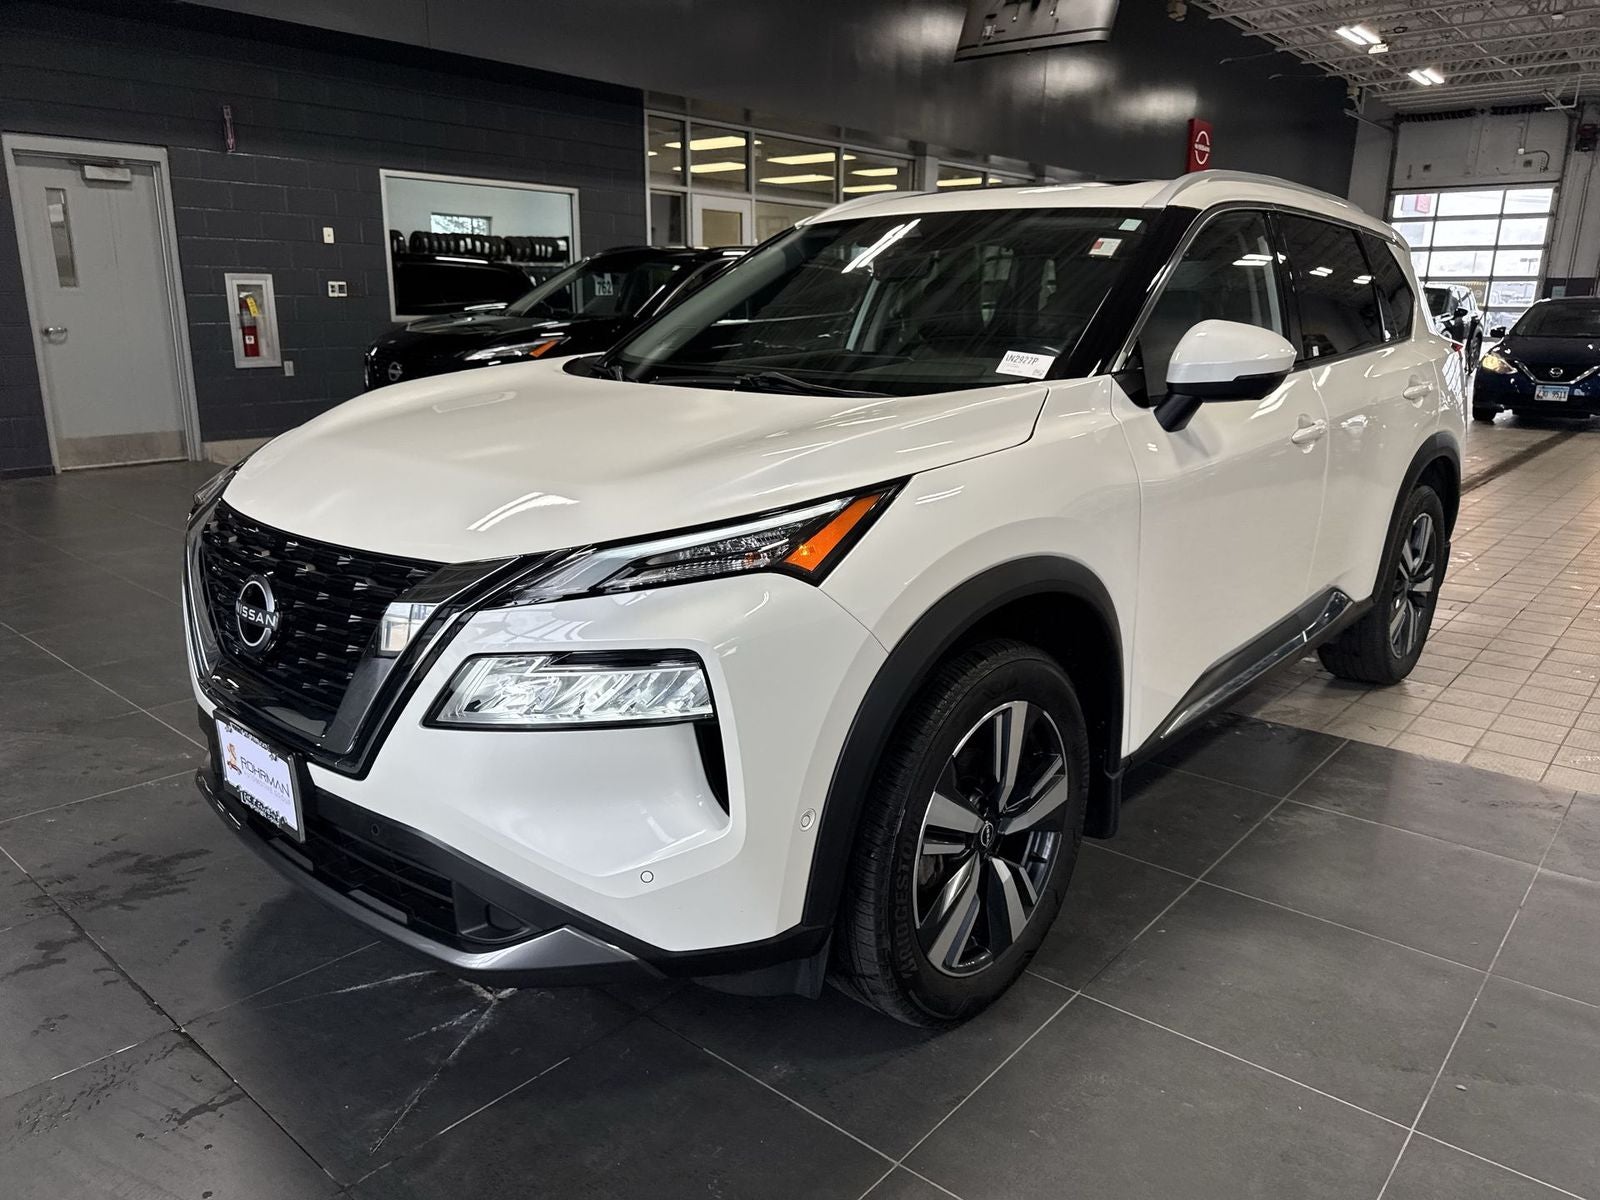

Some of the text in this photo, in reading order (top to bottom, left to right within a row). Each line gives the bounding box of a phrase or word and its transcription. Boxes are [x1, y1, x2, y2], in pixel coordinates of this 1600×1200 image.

[597, 281, 611, 294] 762
[236, 600, 276, 627] NISSAN
[240, 756, 290, 798] ROHRMAN
